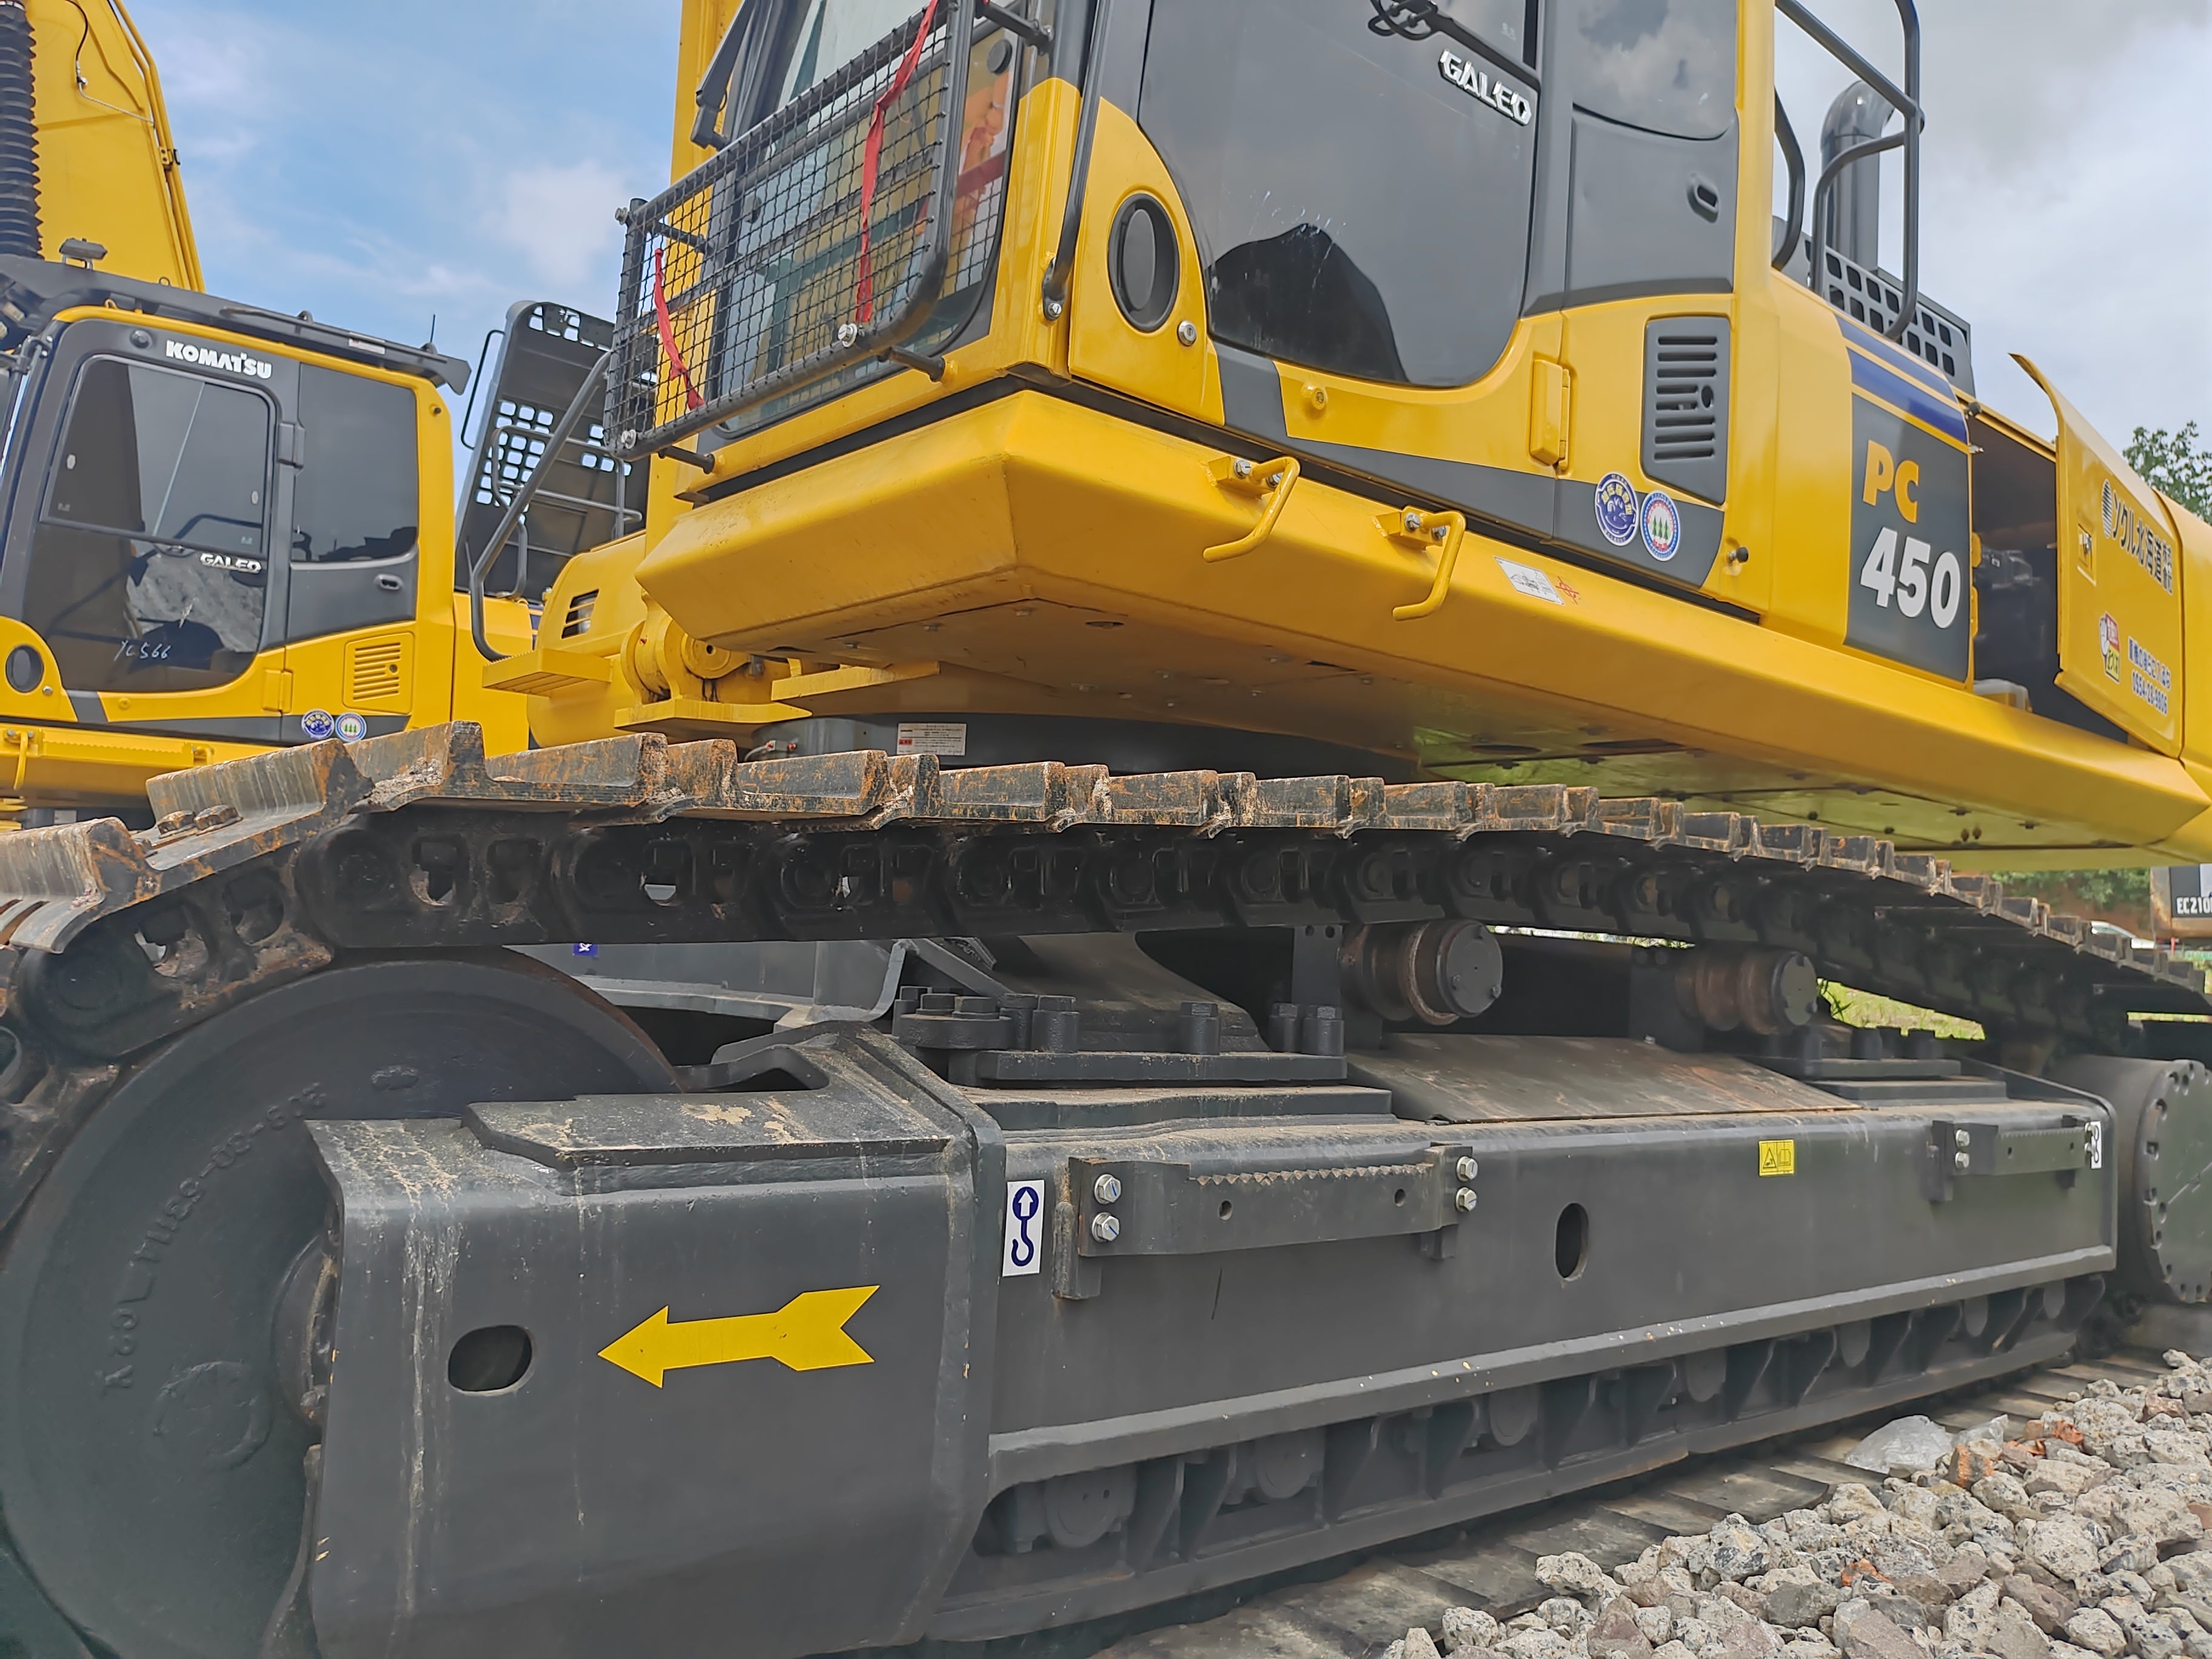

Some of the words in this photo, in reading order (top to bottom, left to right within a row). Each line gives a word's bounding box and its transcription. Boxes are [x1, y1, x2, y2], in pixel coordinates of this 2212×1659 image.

[1438, 49, 1532, 127] GALEO
[166, 339, 272, 379] KOMATSU
[1863, 439, 1919, 523] PC
[1860, 526, 1961, 629] 450
